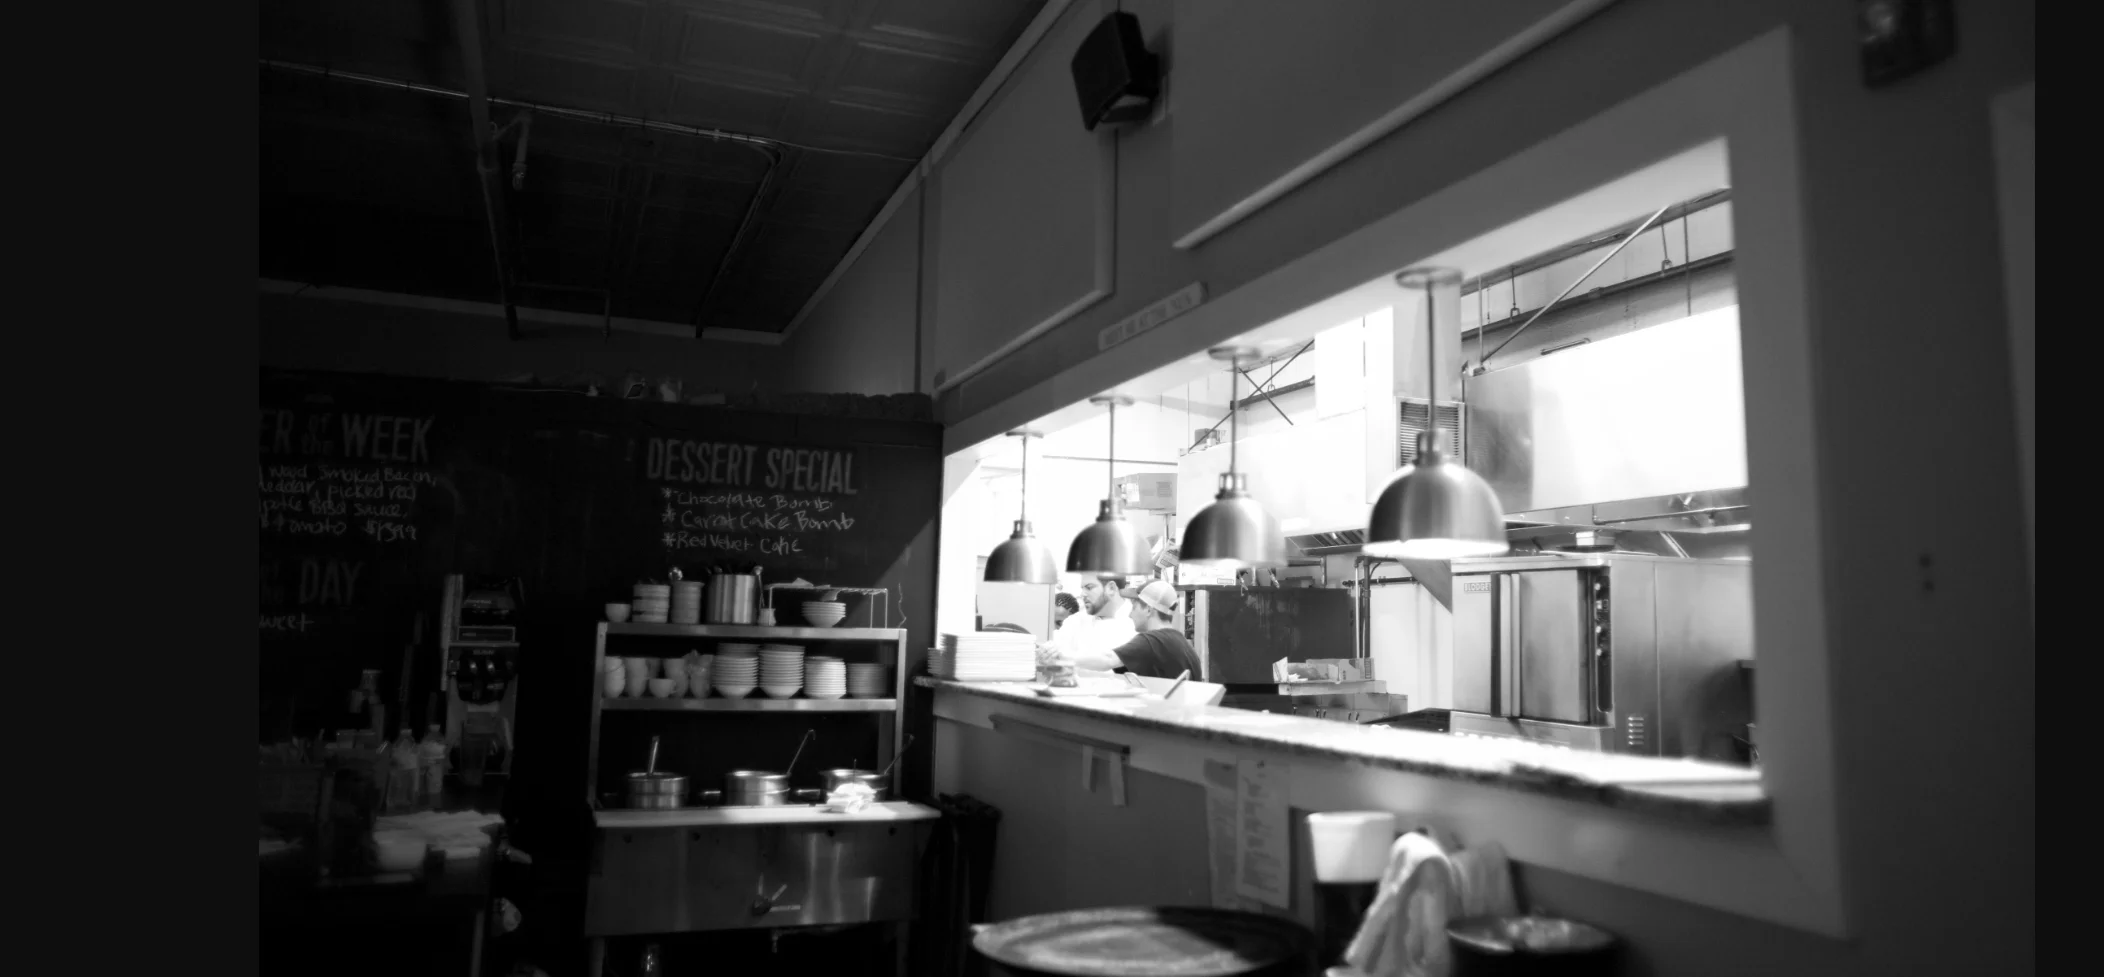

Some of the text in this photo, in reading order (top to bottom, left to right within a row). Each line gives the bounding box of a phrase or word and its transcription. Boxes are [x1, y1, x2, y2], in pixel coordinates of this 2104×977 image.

[341, 412, 436, 464] WEEK
[646, 437, 858, 494] DESSERT SPECIAL
[676, 531, 708, 550] Red
[709, 533, 754, 552] Velvet
[792, 509, 856, 532] Bomb
[298, 556, 367, 606] DAY
